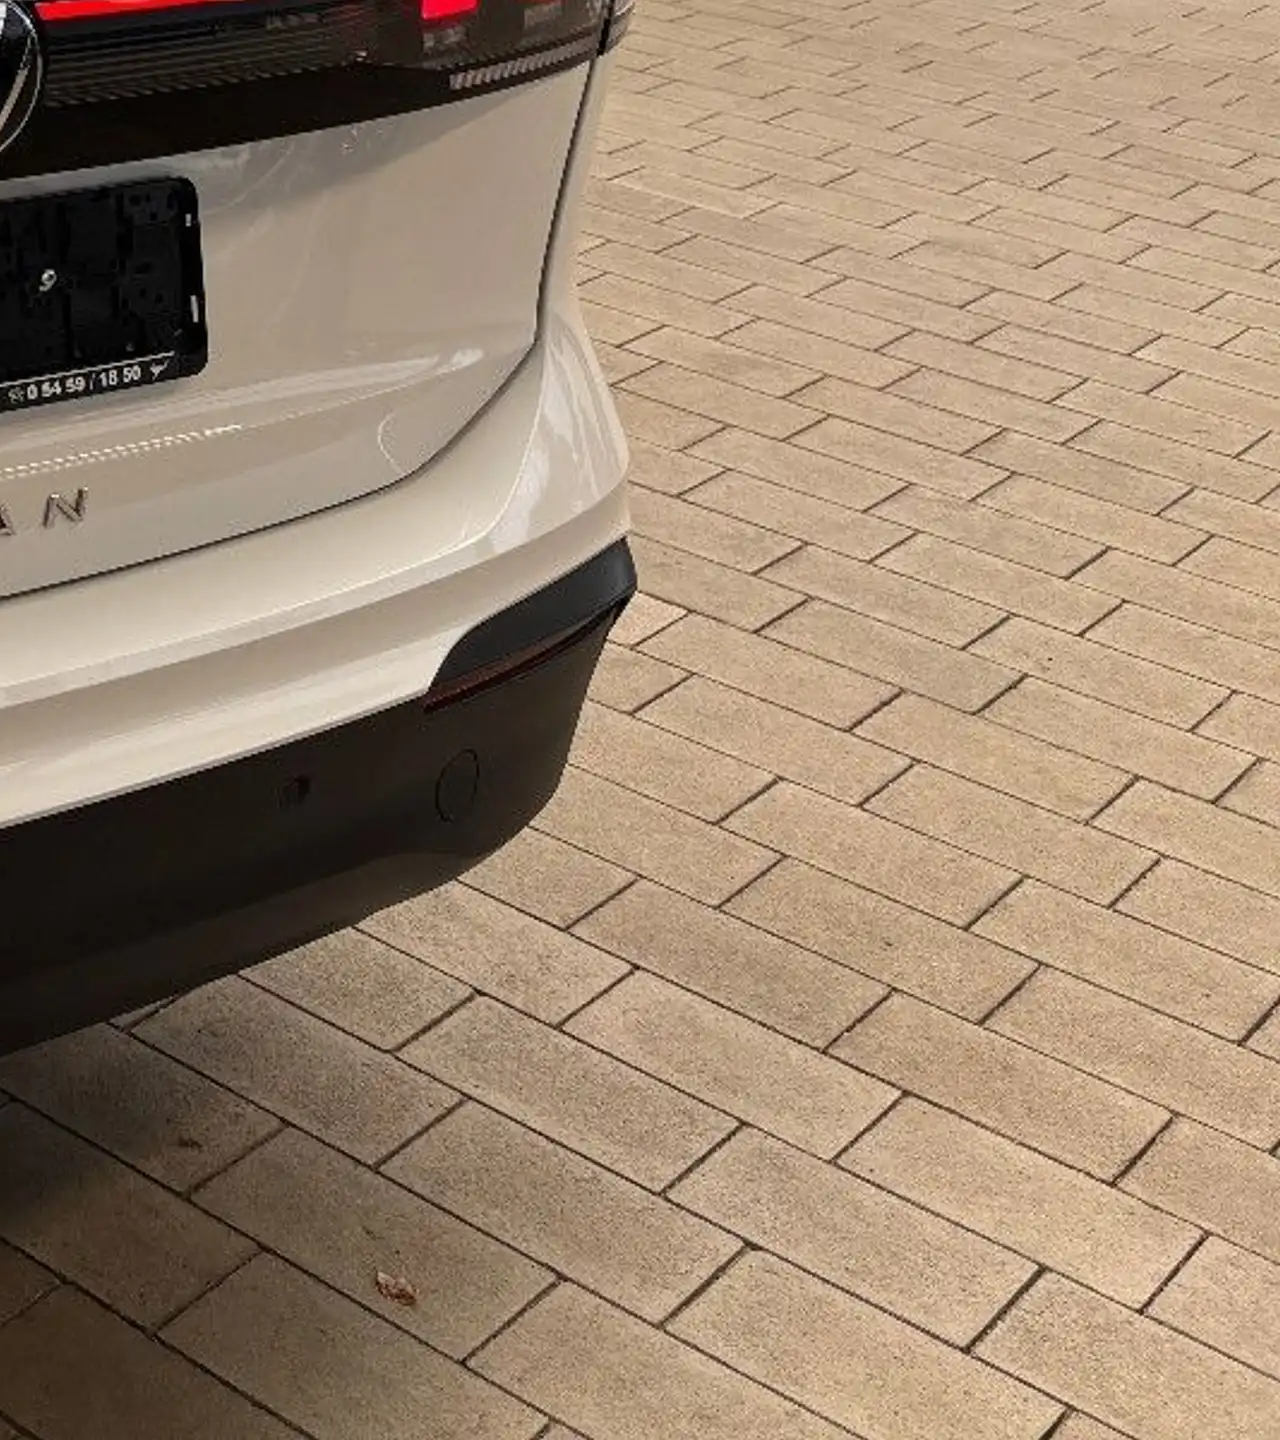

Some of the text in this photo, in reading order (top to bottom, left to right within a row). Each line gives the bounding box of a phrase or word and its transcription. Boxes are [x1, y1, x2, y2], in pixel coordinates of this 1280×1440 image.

[65, 375, 85, 394] 59
[100, 370, 117, 388] 18
[122, 364, 142, 382] 50
